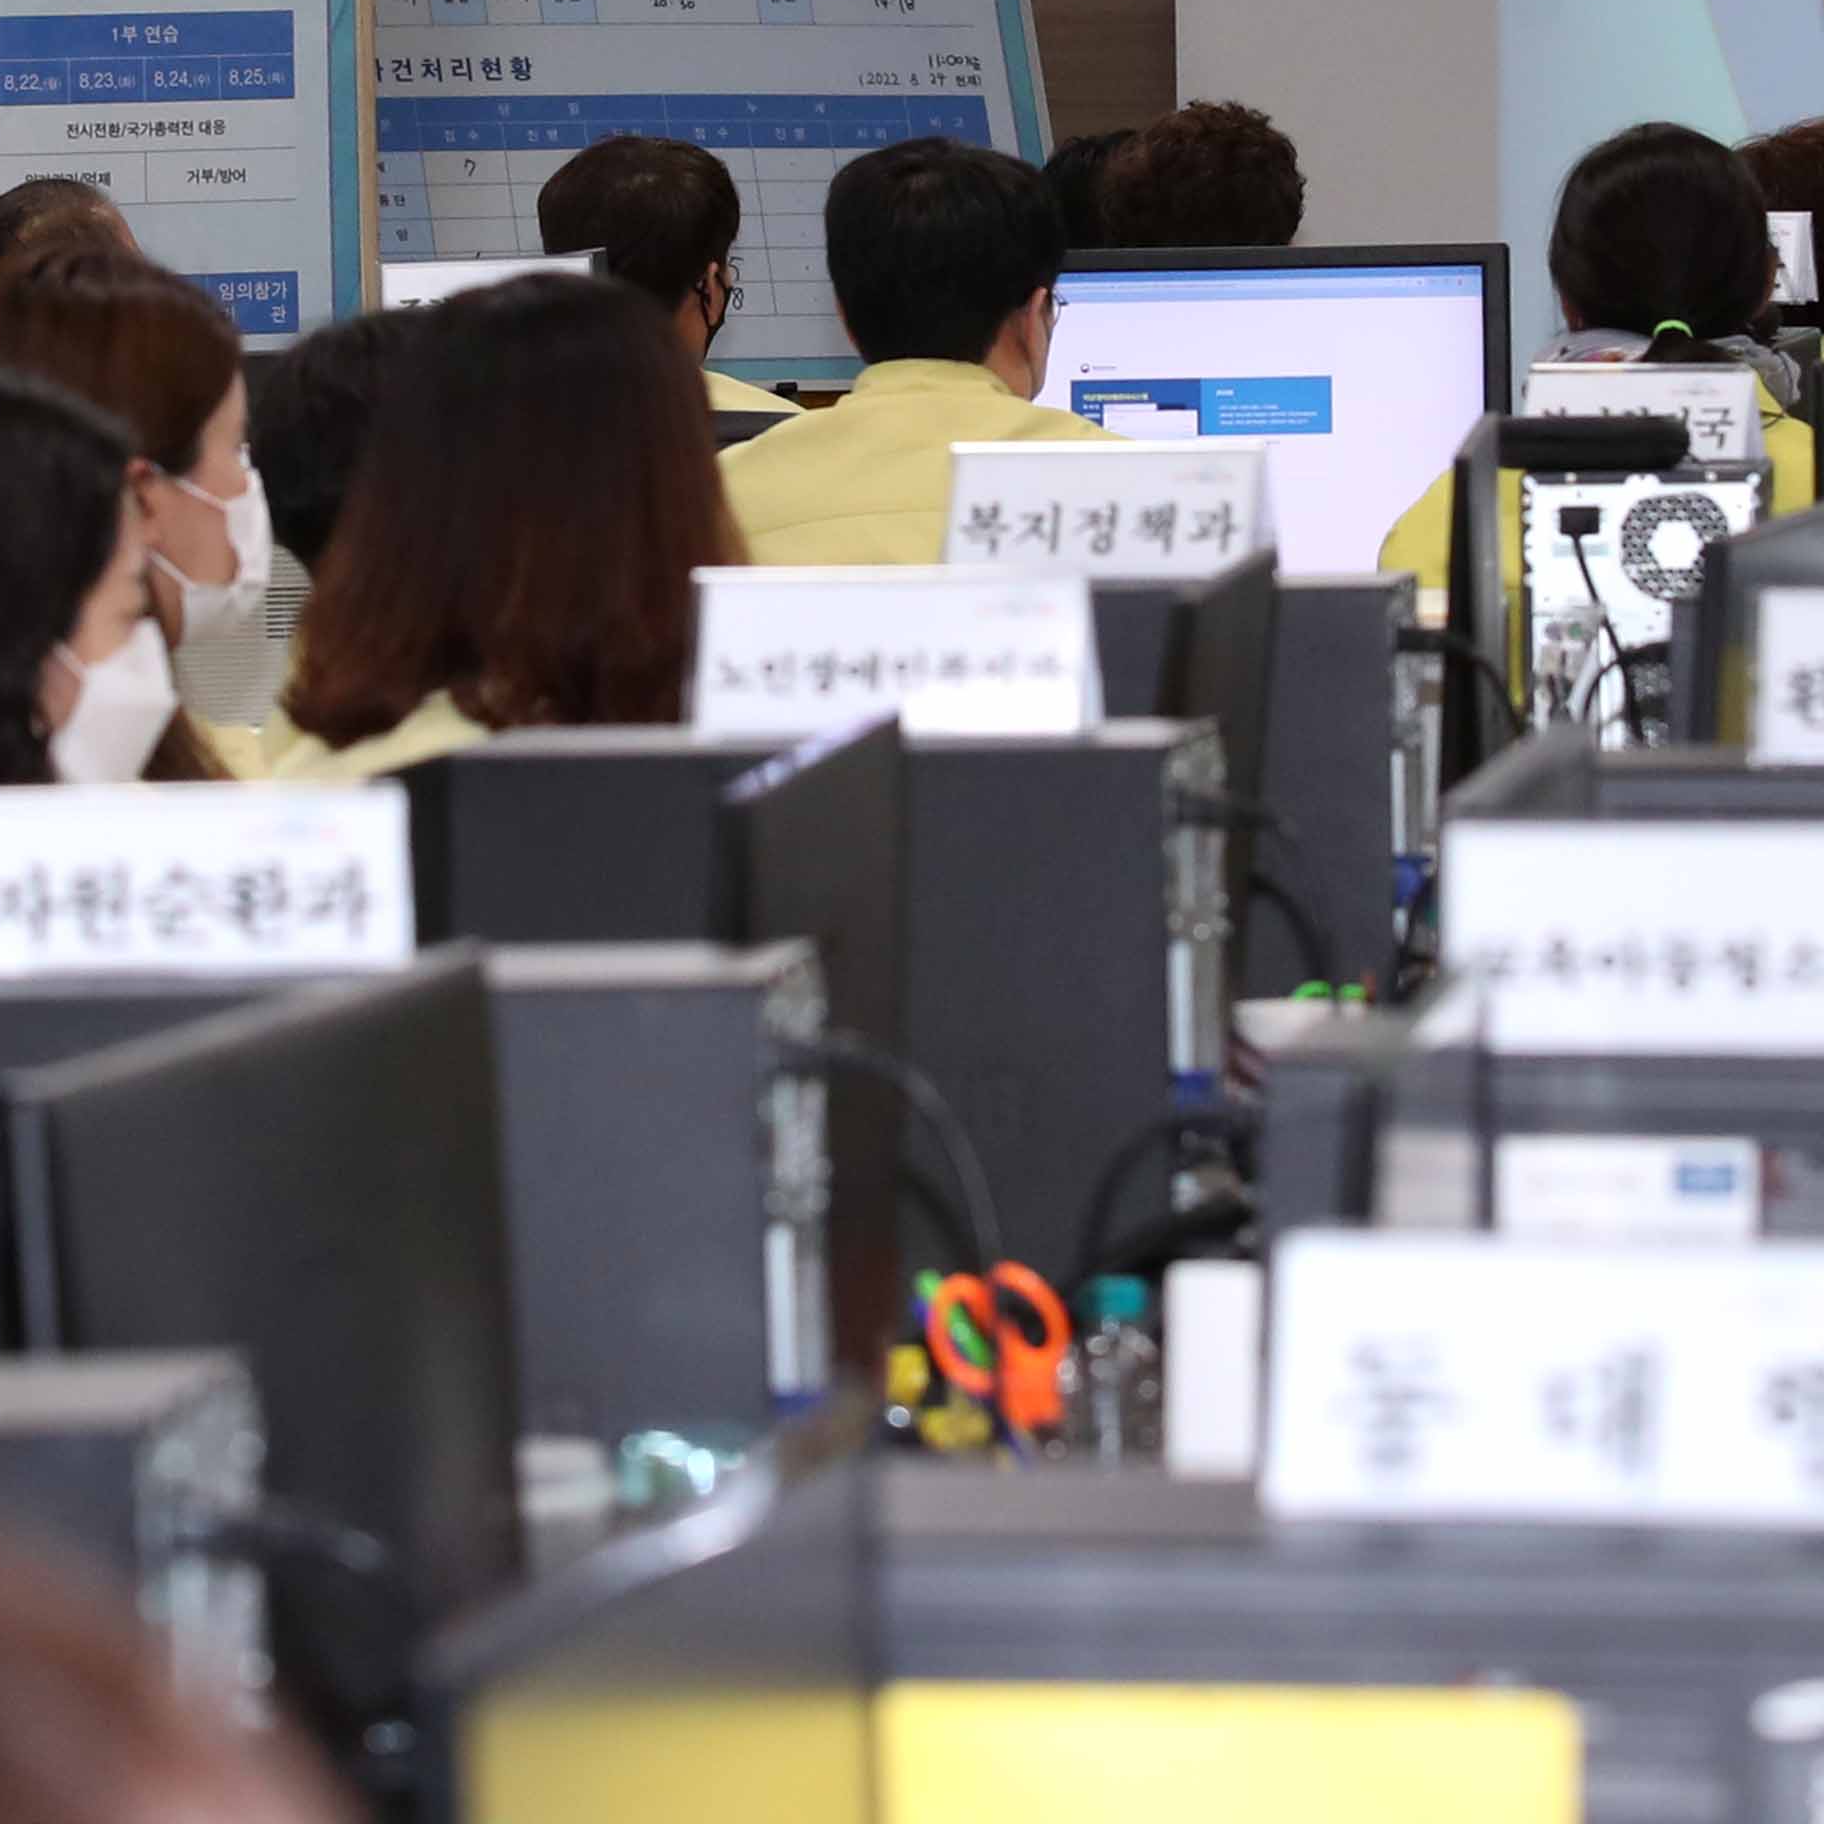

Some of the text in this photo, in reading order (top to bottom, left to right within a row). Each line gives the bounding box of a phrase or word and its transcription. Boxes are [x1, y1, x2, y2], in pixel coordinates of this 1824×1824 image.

[112, 25, 179, 44] 1부 연습
[66, 119, 227, 139] 전시전환/국가총력전 대응
[186, 168, 248, 186] 거부/방어
[218, 280, 288, 302] 임의참가
[958, 500, 1243, 556] 복지정책과
